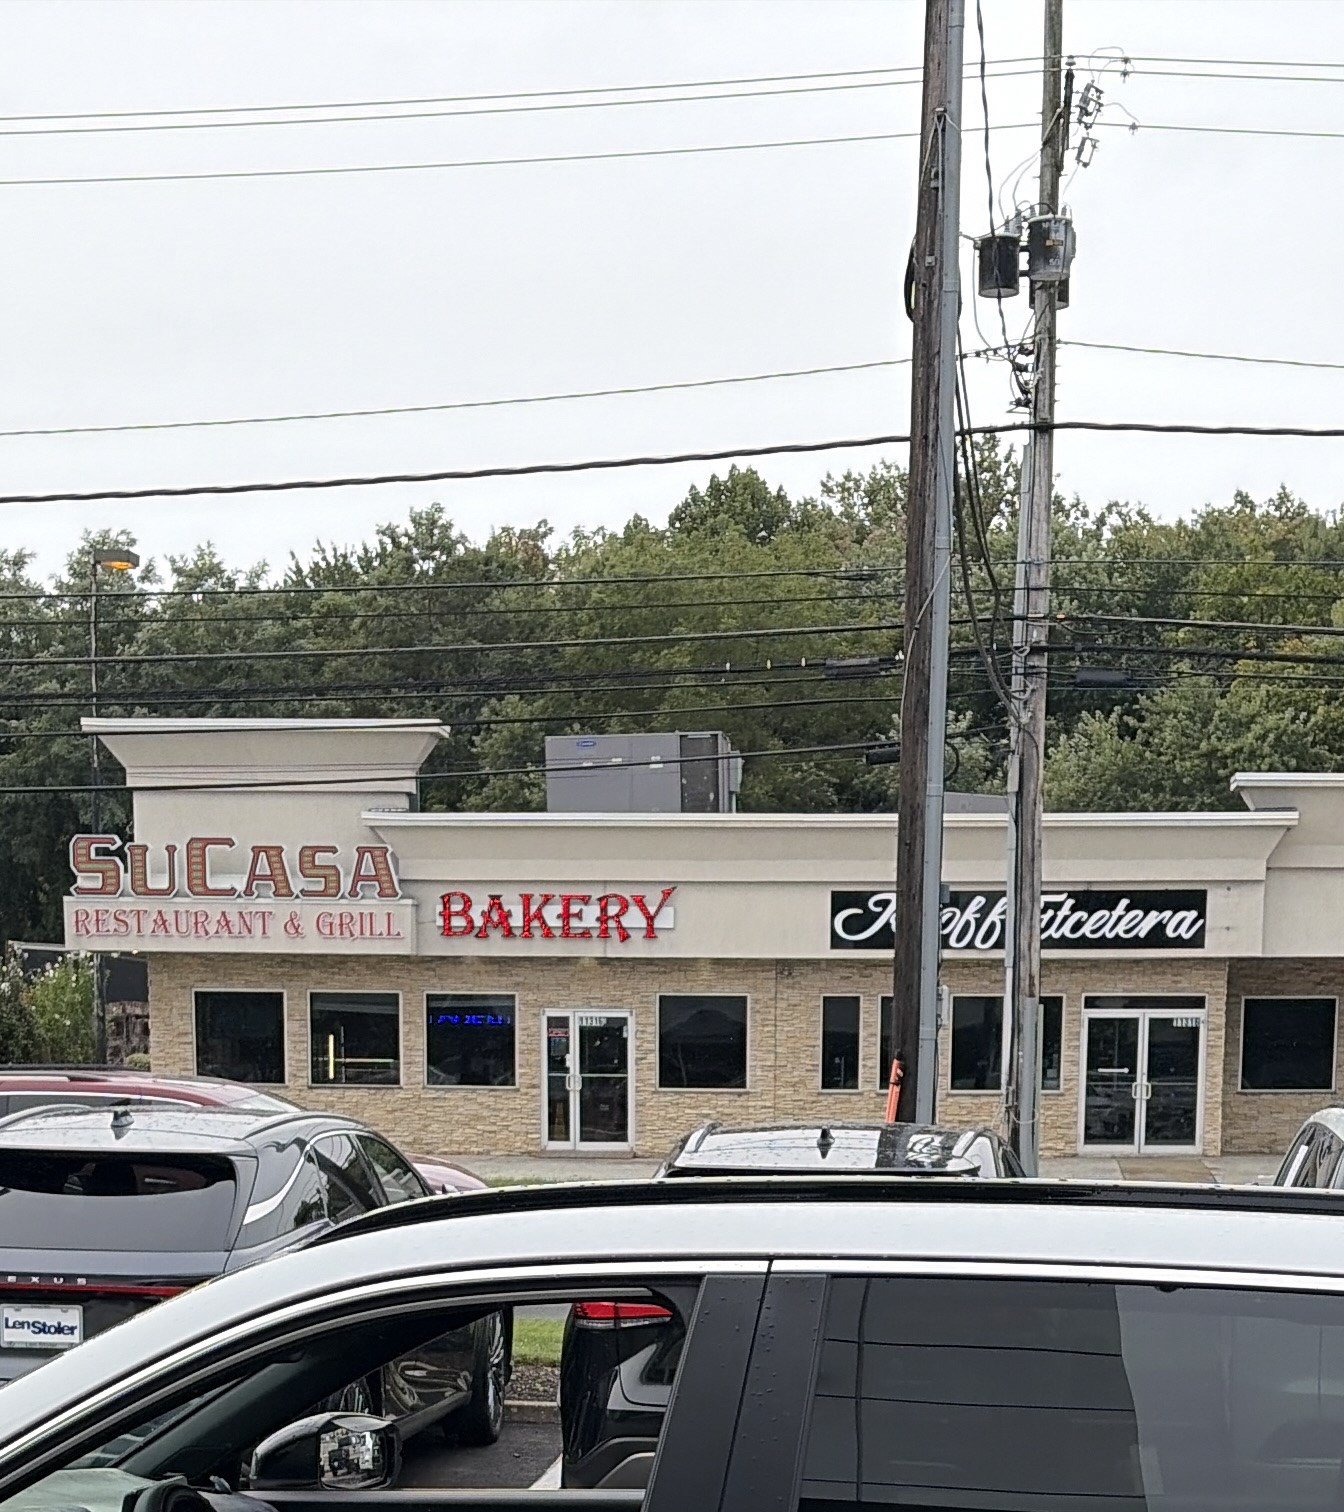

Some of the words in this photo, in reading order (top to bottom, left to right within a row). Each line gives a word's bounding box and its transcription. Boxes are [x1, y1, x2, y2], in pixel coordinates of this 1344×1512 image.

[73, 908, 274, 938] RESTAURANT
[283, 910, 305, 938] &
[315, 911, 404, 939] GRILL
[438, 886, 678, 943] BAKERY
